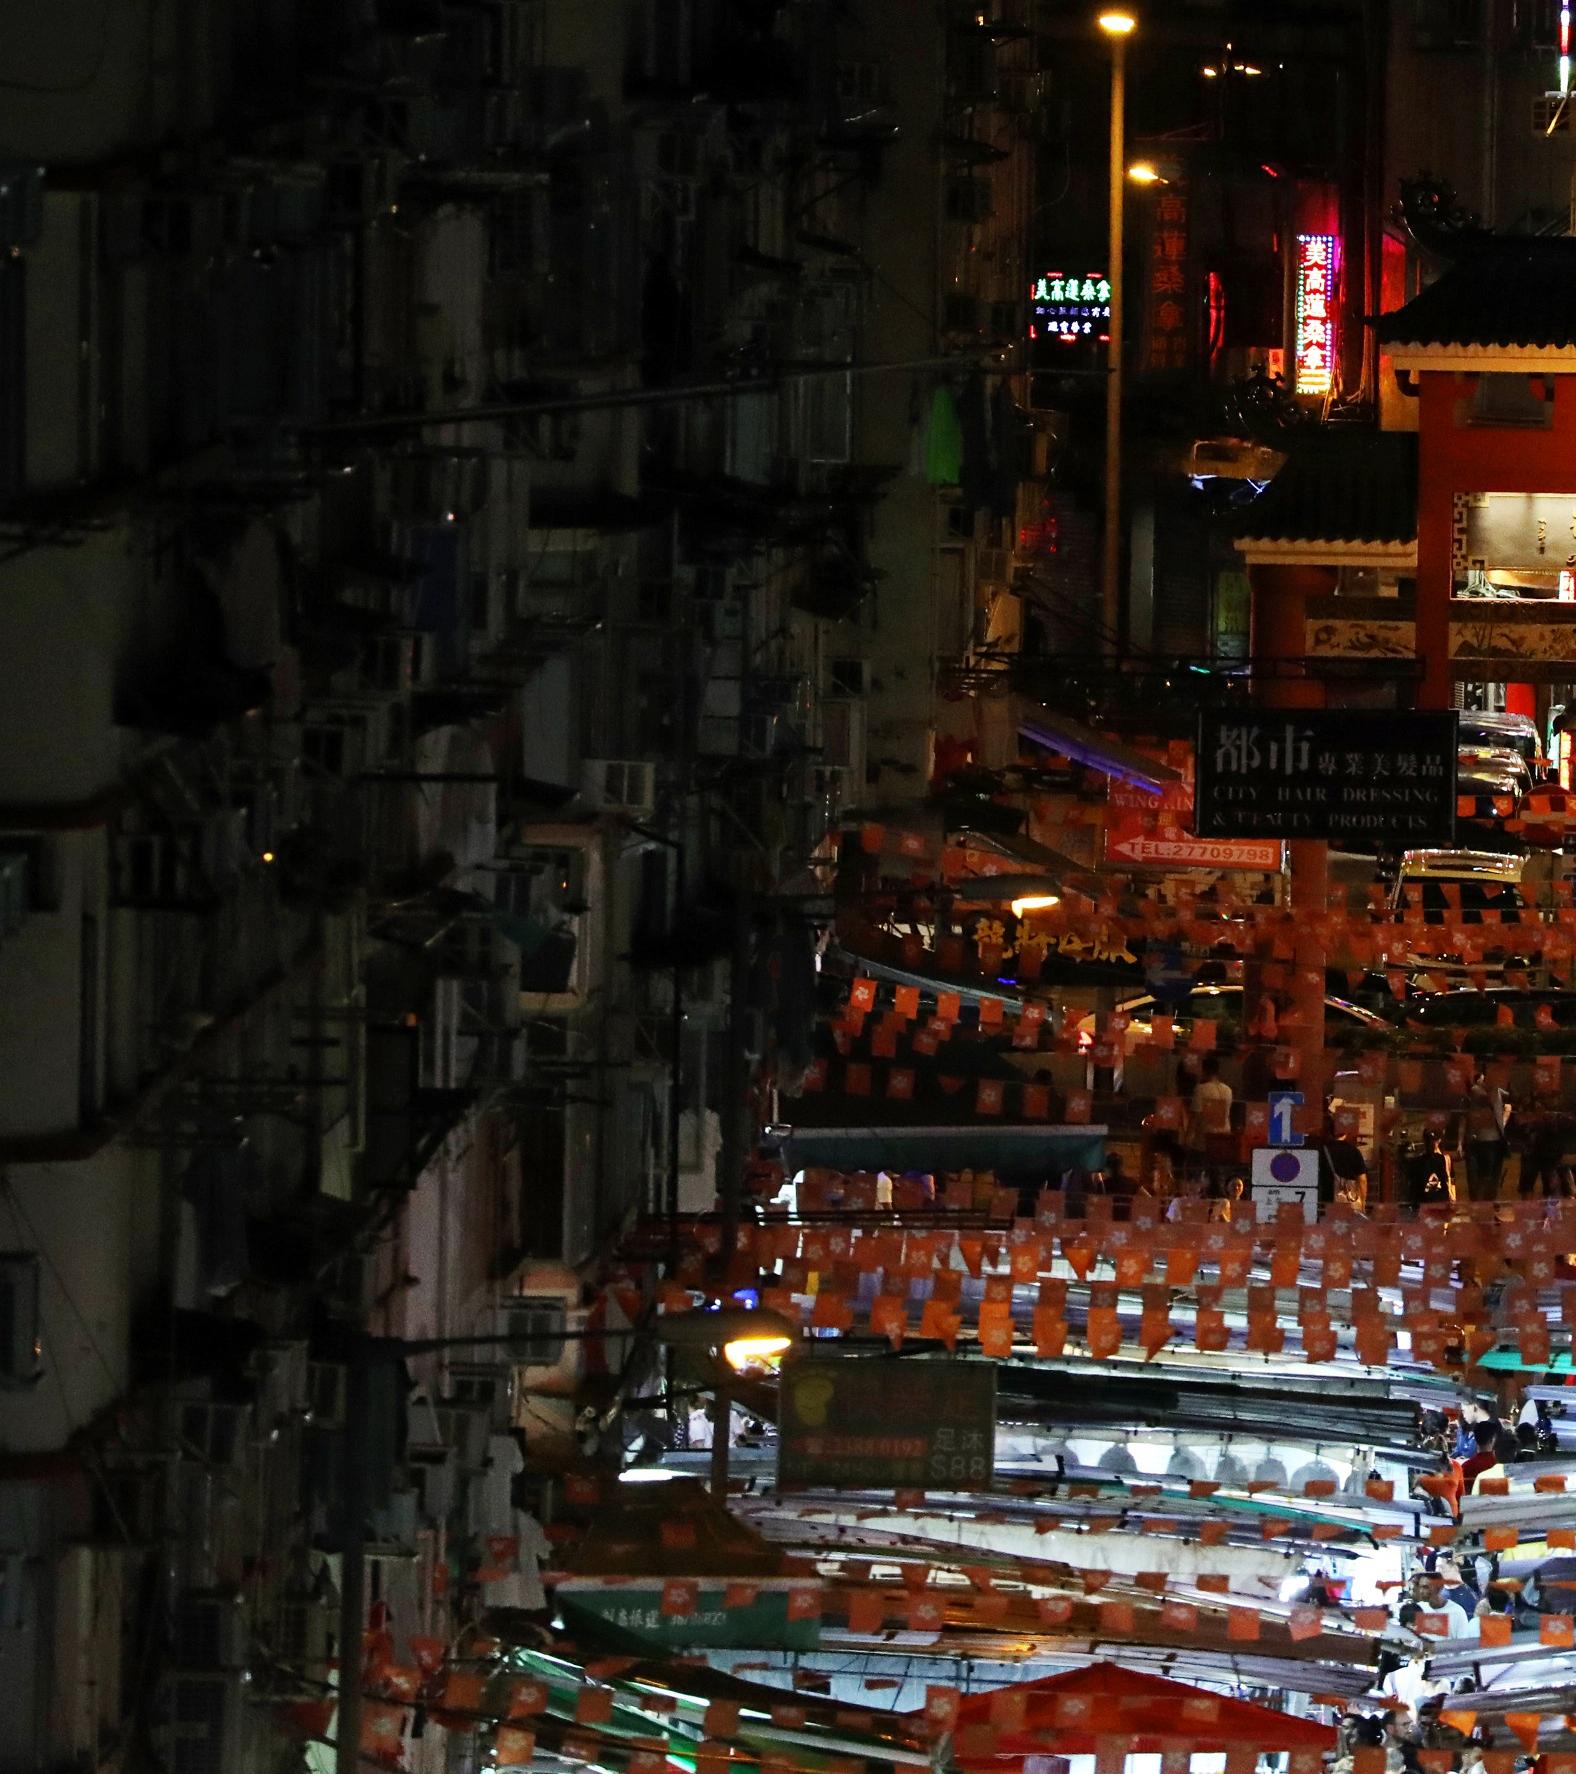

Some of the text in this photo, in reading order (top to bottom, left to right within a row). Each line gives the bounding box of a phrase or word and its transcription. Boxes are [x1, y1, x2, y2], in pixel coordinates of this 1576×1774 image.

[1213, 785, 1440, 803] CITY HAIR DRESSING
[1131, 841, 1271, 862] TEL:27709798
